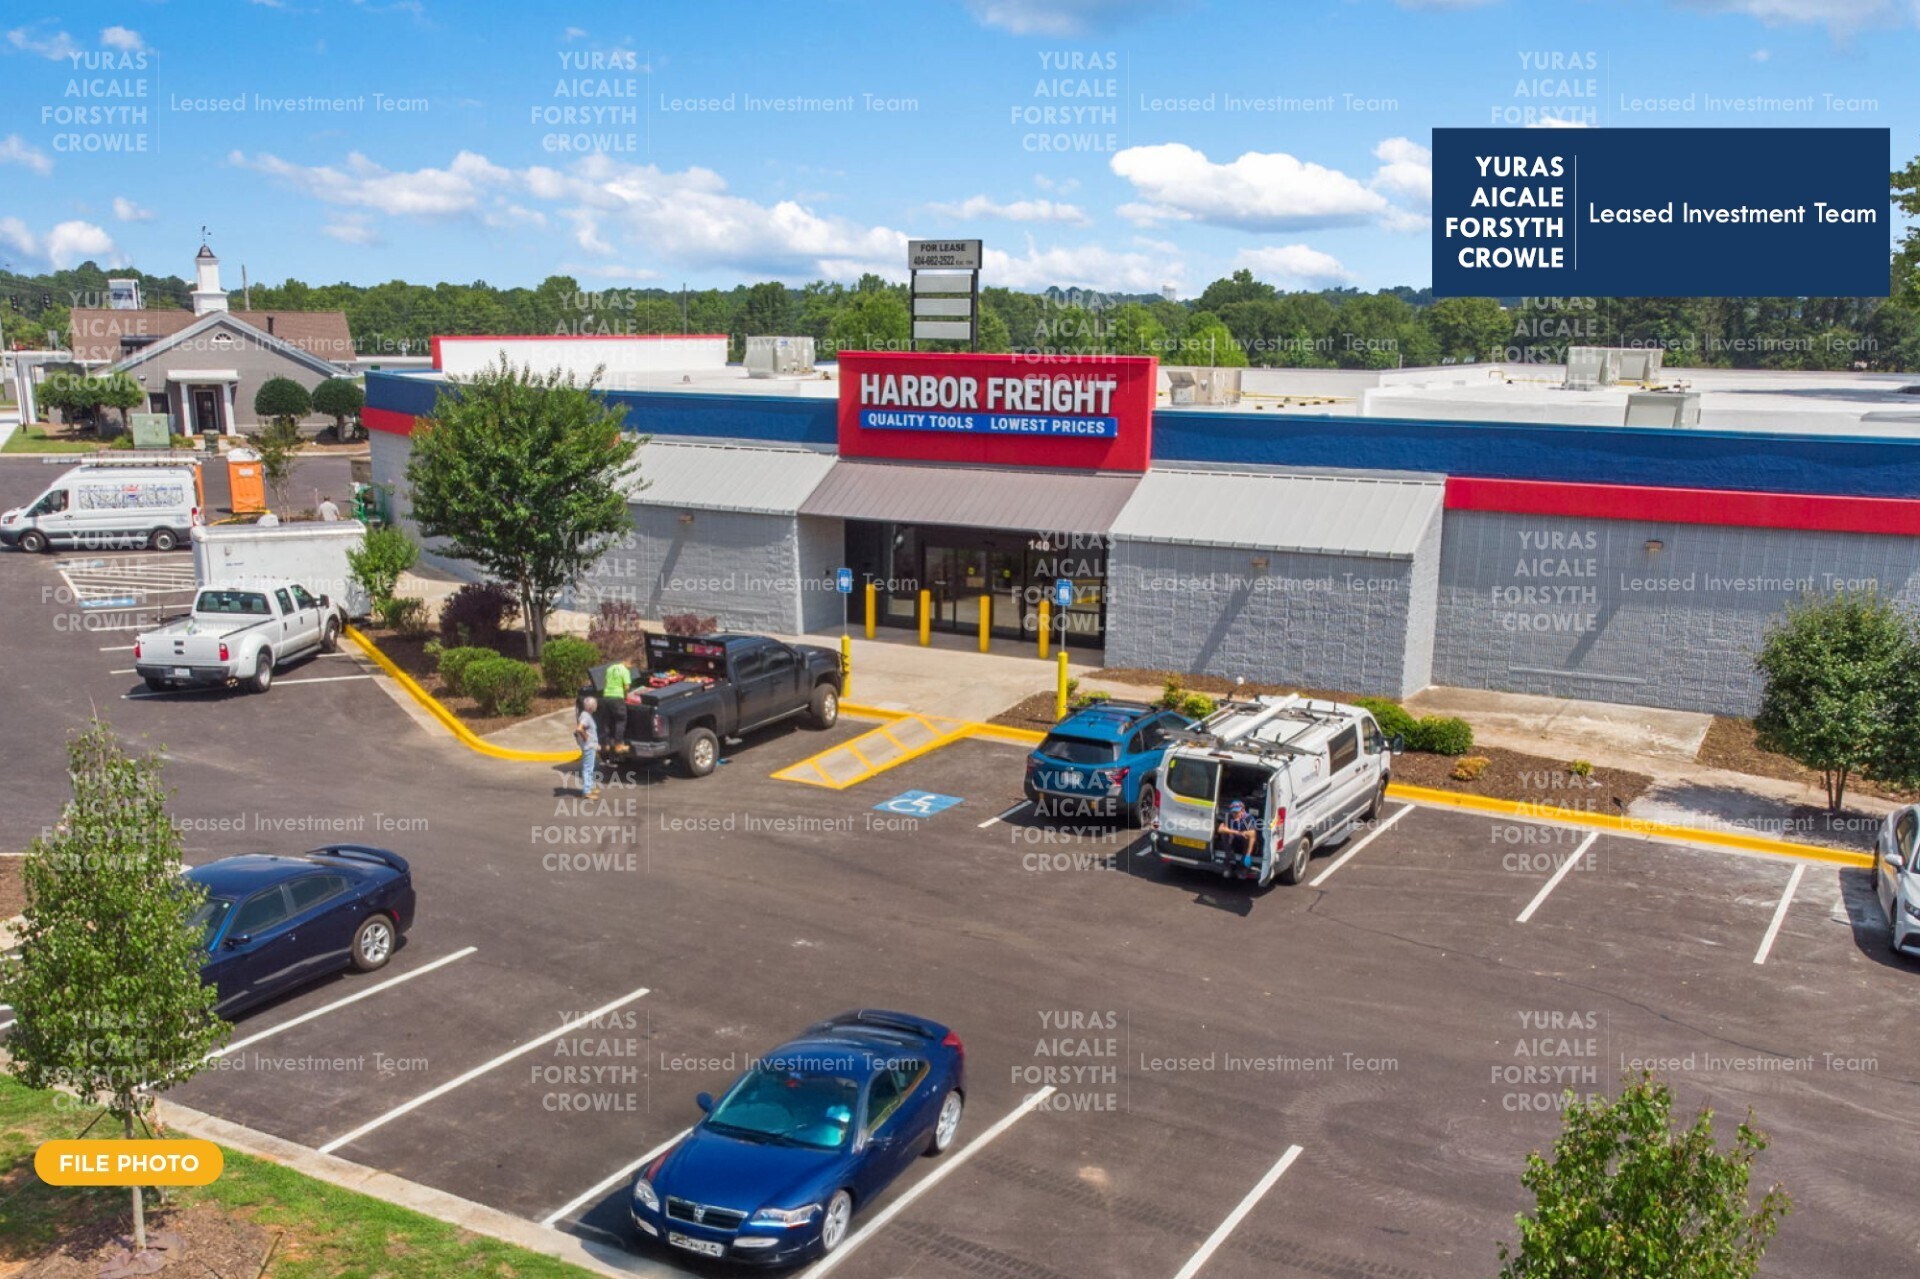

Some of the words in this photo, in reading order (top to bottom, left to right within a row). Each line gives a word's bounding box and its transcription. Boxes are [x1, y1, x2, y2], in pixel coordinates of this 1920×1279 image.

[920, 243, 937, 252] FOR
[939, 243, 967, 252] LEASE
[861, 373, 978, 409] HARBOR
[987, 377, 1117, 414] FREIGHT
[868, 413, 926, 428] QUALITY
[929, 416, 974, 430] TOOLS
[990, 417, 1046, 432] LOWEST
[1052, 419, 1105, 434] PRICES
